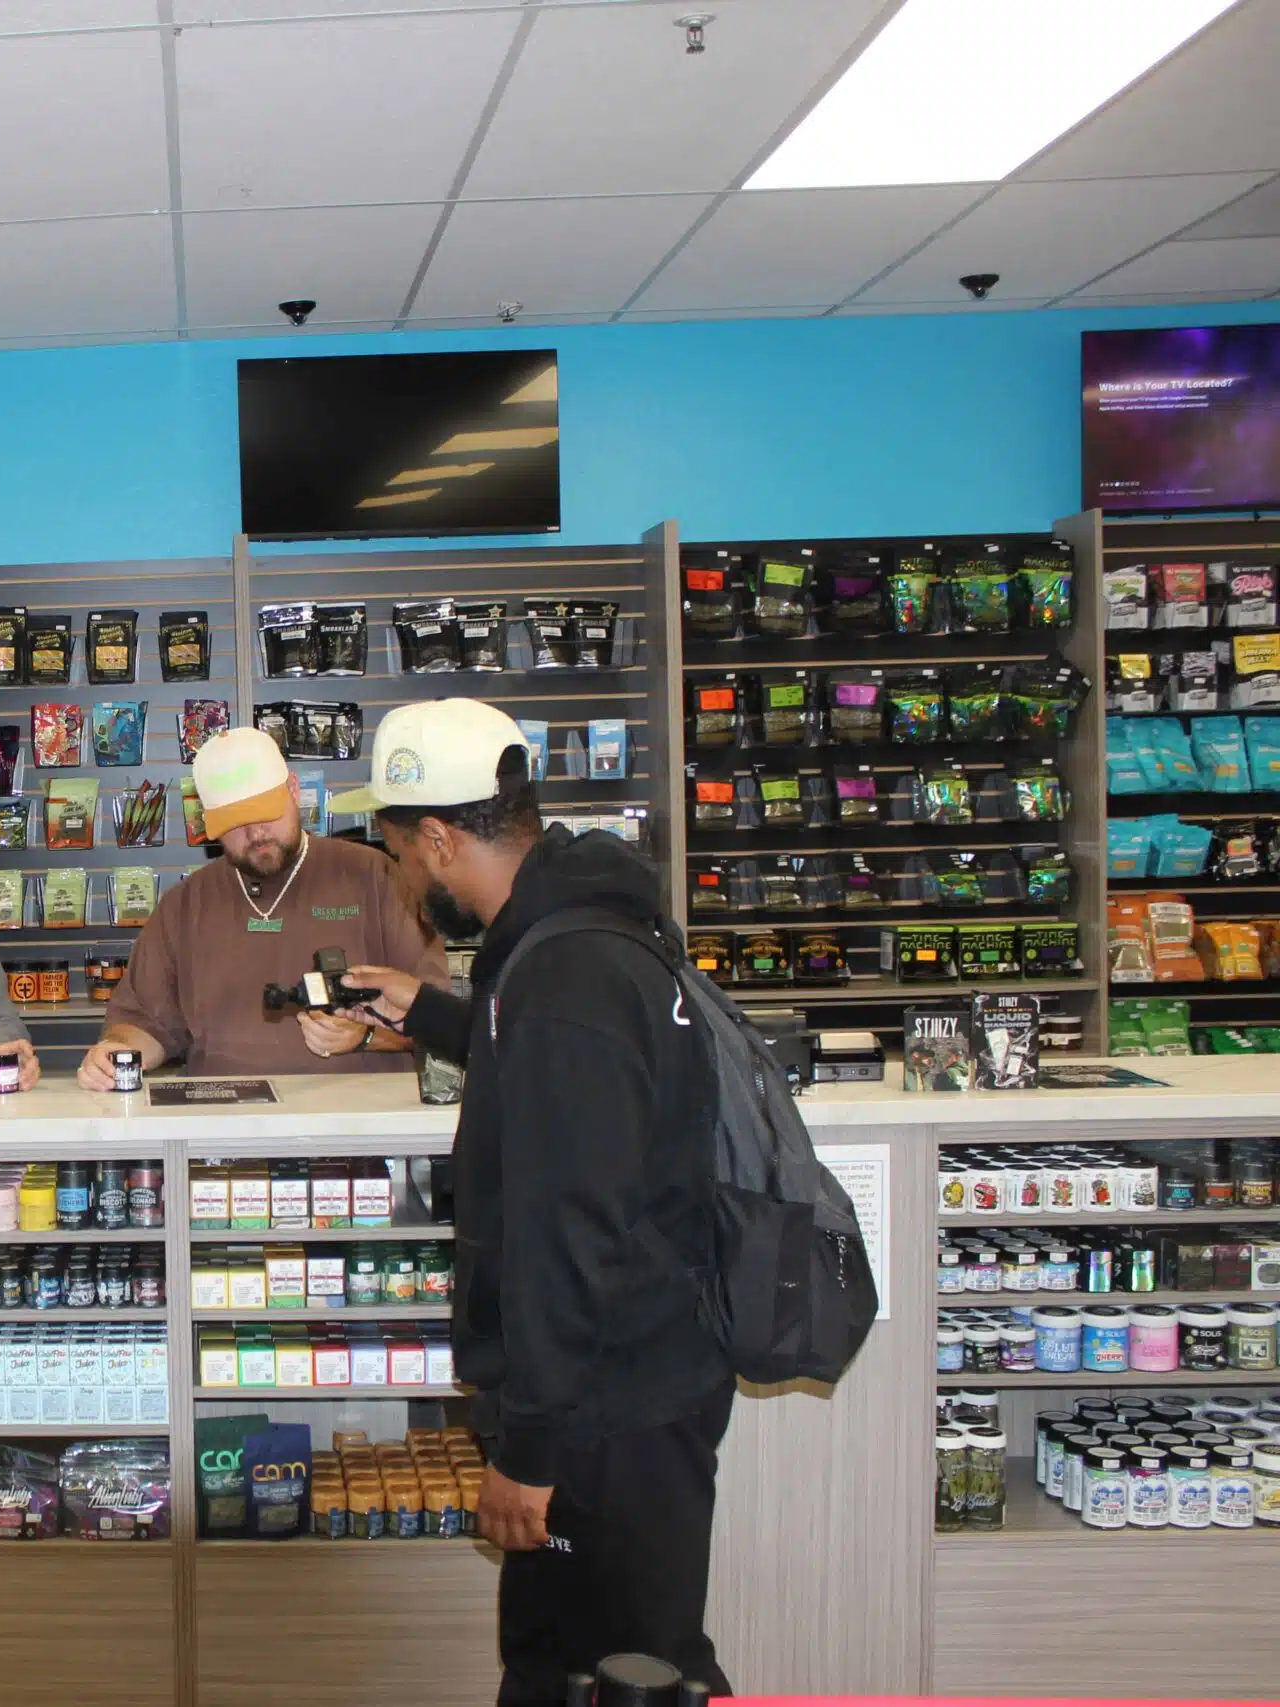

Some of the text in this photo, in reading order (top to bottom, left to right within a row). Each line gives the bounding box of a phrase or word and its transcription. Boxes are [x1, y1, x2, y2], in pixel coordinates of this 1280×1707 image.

[1098, 378, 1233, 392] Where is Your TV Located?
[900, 941, 951, 950] MACHINE
[961, 941, 1014, 950] MACHINE
[1024, 938, 1077, 947] MACHINE
[984, 1012, 1032, 1022] LIQUID
[915, 1017, 959, 1038] STIIIZY
[252, 1461, 307, 1482] cam
